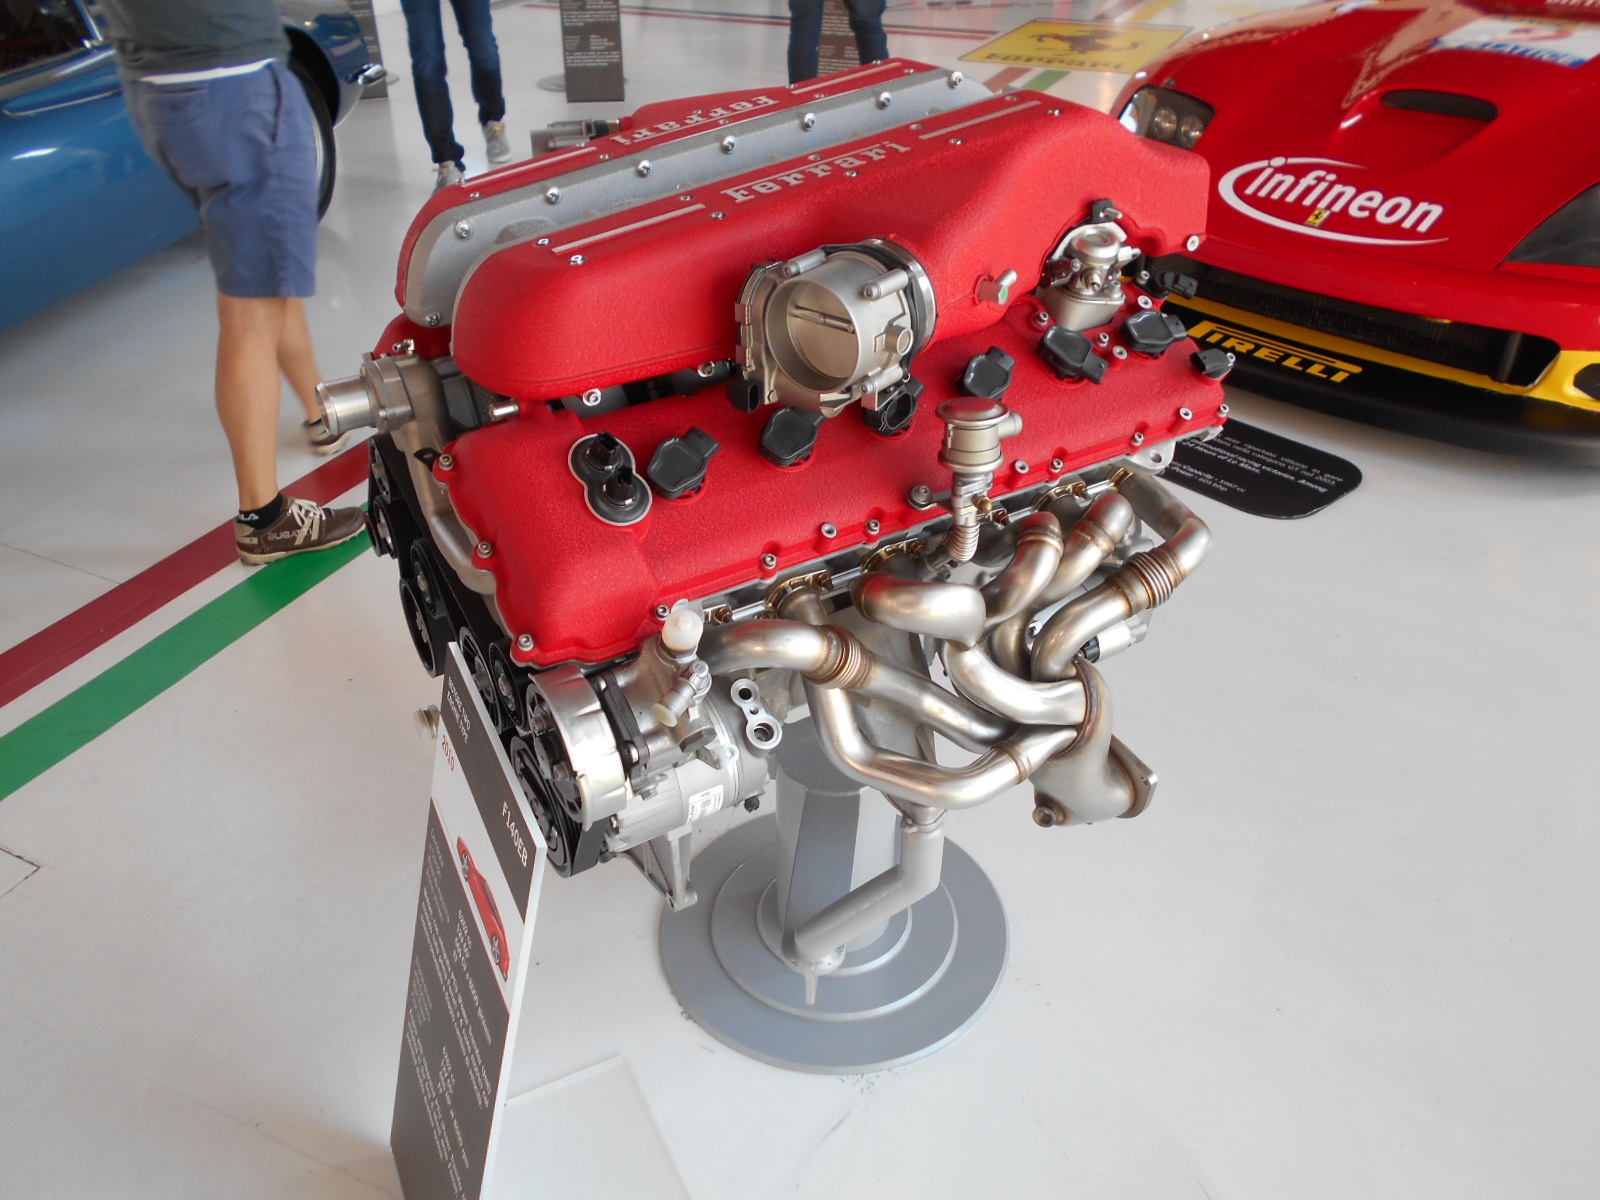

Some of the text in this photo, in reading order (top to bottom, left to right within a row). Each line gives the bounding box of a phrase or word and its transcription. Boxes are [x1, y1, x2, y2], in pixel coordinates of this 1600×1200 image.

[720, 141, 911, 203] Ferrari
[1186, 320, 1363, 384] PIRELLI
[441, 734, 455, 772] 2010
[502, 801, 528, 868] F140EB
